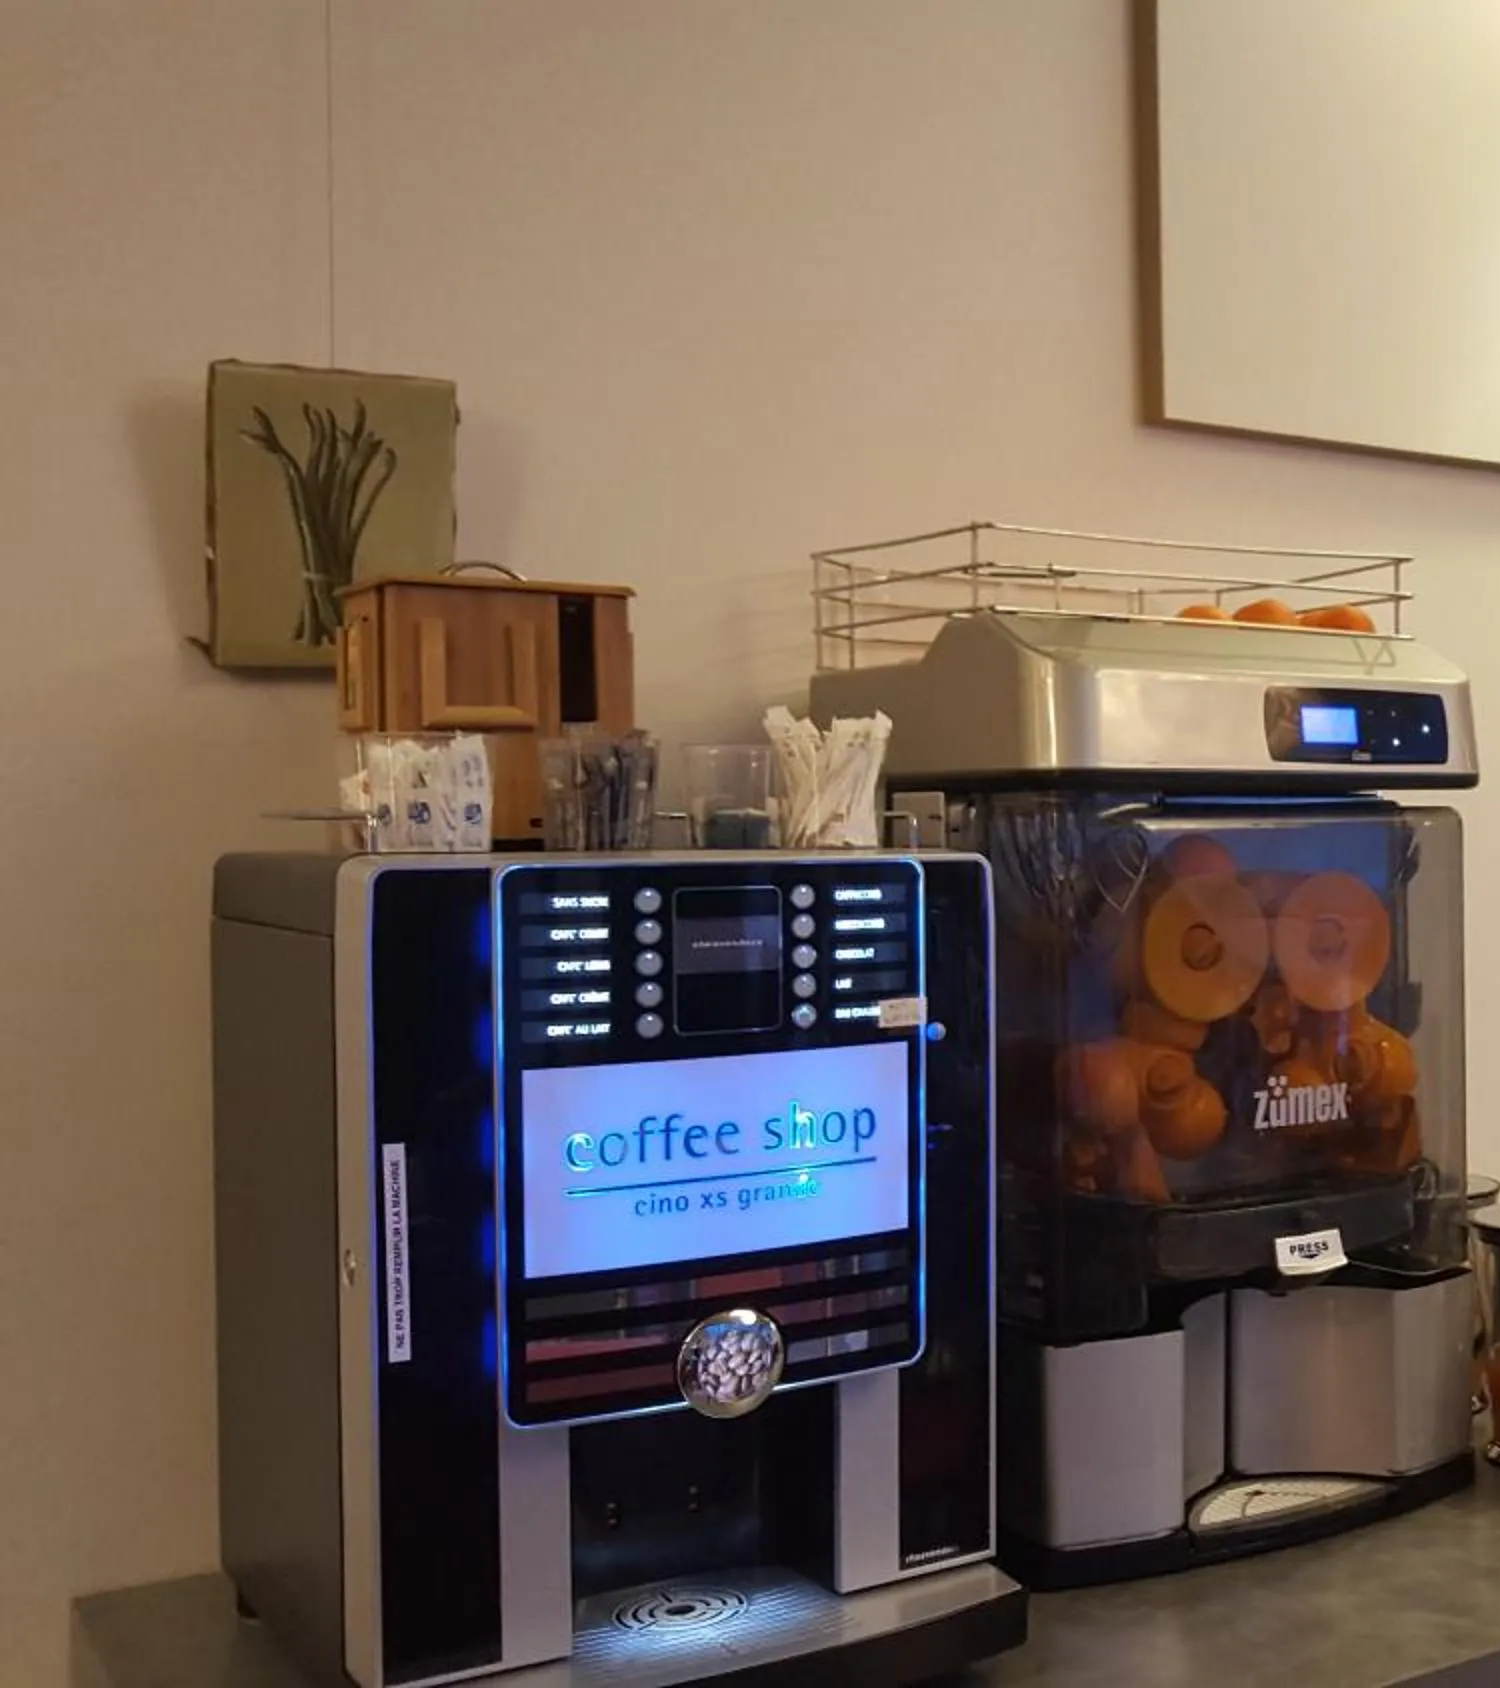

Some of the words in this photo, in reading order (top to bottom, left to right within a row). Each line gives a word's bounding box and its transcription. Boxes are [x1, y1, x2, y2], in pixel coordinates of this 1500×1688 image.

[565, 1112, 741, 1173] coffee
[762, 1099, 878, 1154] shop
[633, 1191, 690, 1217] cino
[699, 1188, 728, 1210] xs
[391, 1209, 403, 1225] LA
[1288, 1240, 1330, 1256] PRESS
